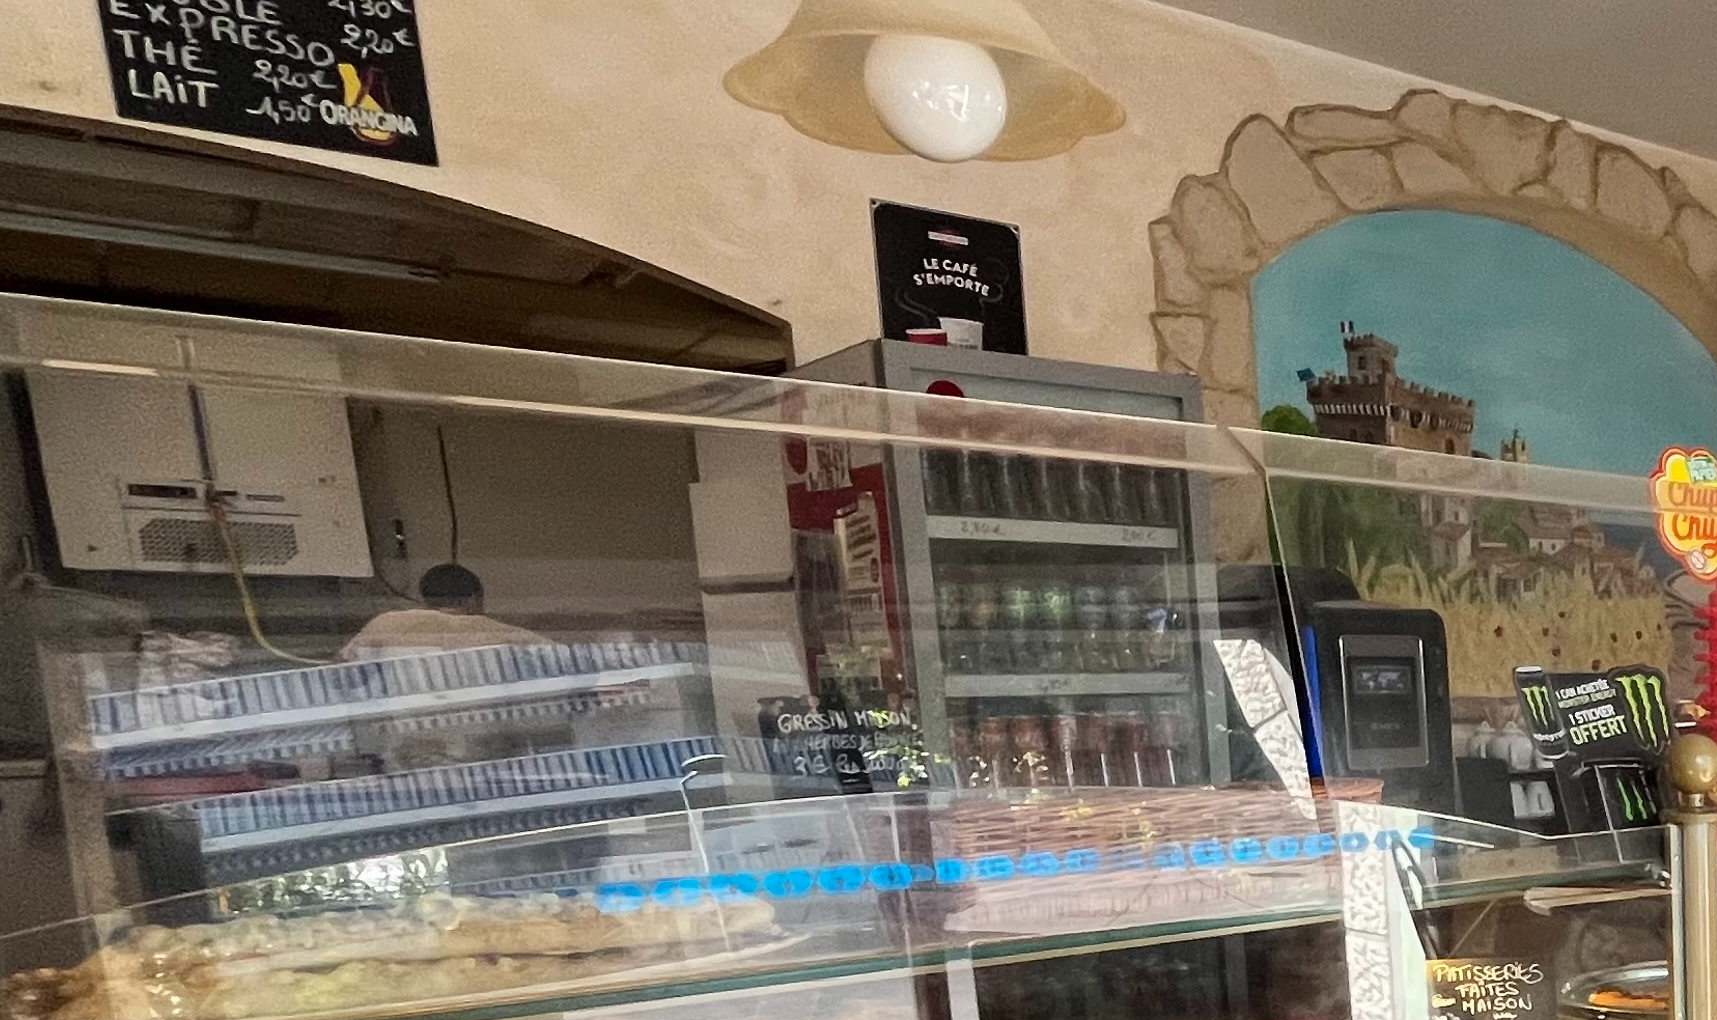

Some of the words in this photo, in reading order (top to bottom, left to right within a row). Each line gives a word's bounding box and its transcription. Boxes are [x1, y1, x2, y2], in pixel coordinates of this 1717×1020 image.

[109, 0, 335, 66] EXPRESSO
[319, 99, 418, 136] ORANGINA
[923, 257, 940, 270] LE
[942, 259, 978, 277] CAFÉ
[913, 273, 989, 296] S'EMPORTE
[1575, 704, 1616, 724] STICKER
[1570, 716, 1626, 745] OFFERT
[1461, 993, 1533, 1015] MAISON
